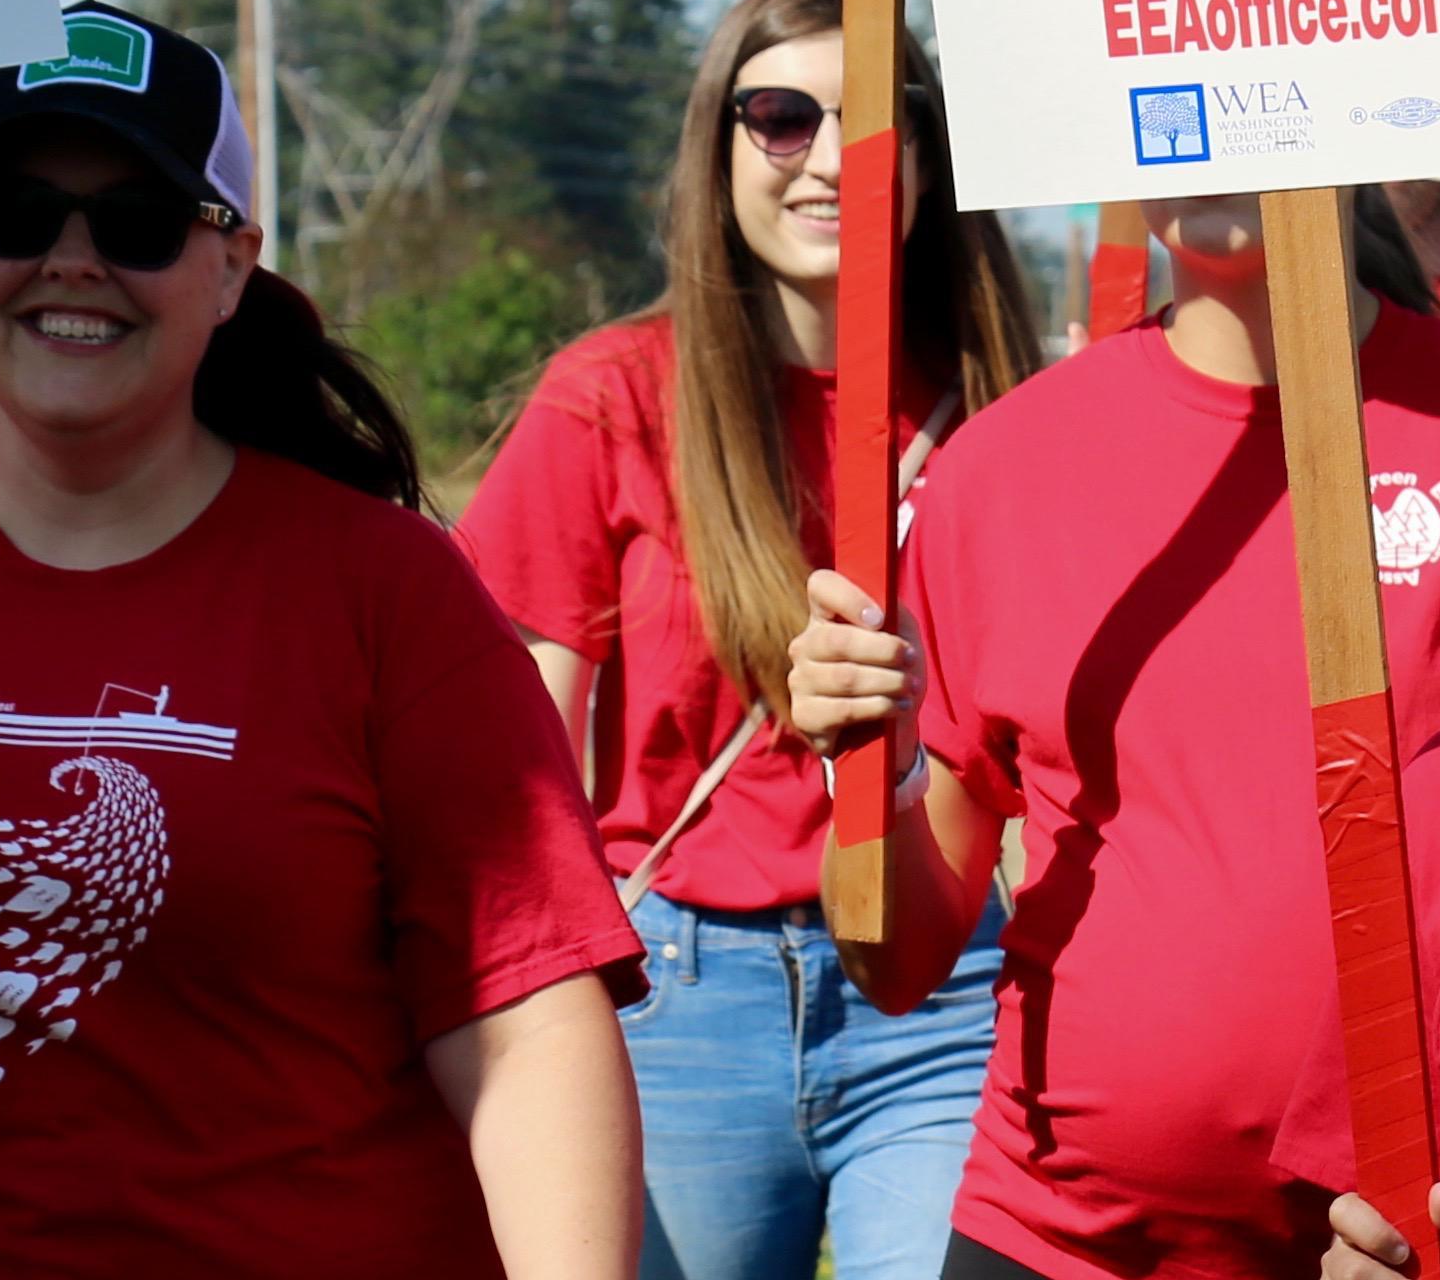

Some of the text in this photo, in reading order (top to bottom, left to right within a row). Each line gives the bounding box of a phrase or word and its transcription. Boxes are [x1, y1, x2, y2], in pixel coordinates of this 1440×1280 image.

[1211, 80, 1310, 116] WEA
[1216, 114, 1315, 132] WASHINGTON
[1224, 127, 1308, 144] EDUCATION
[1219, 139, 1317, 157] ASSOCIATION
